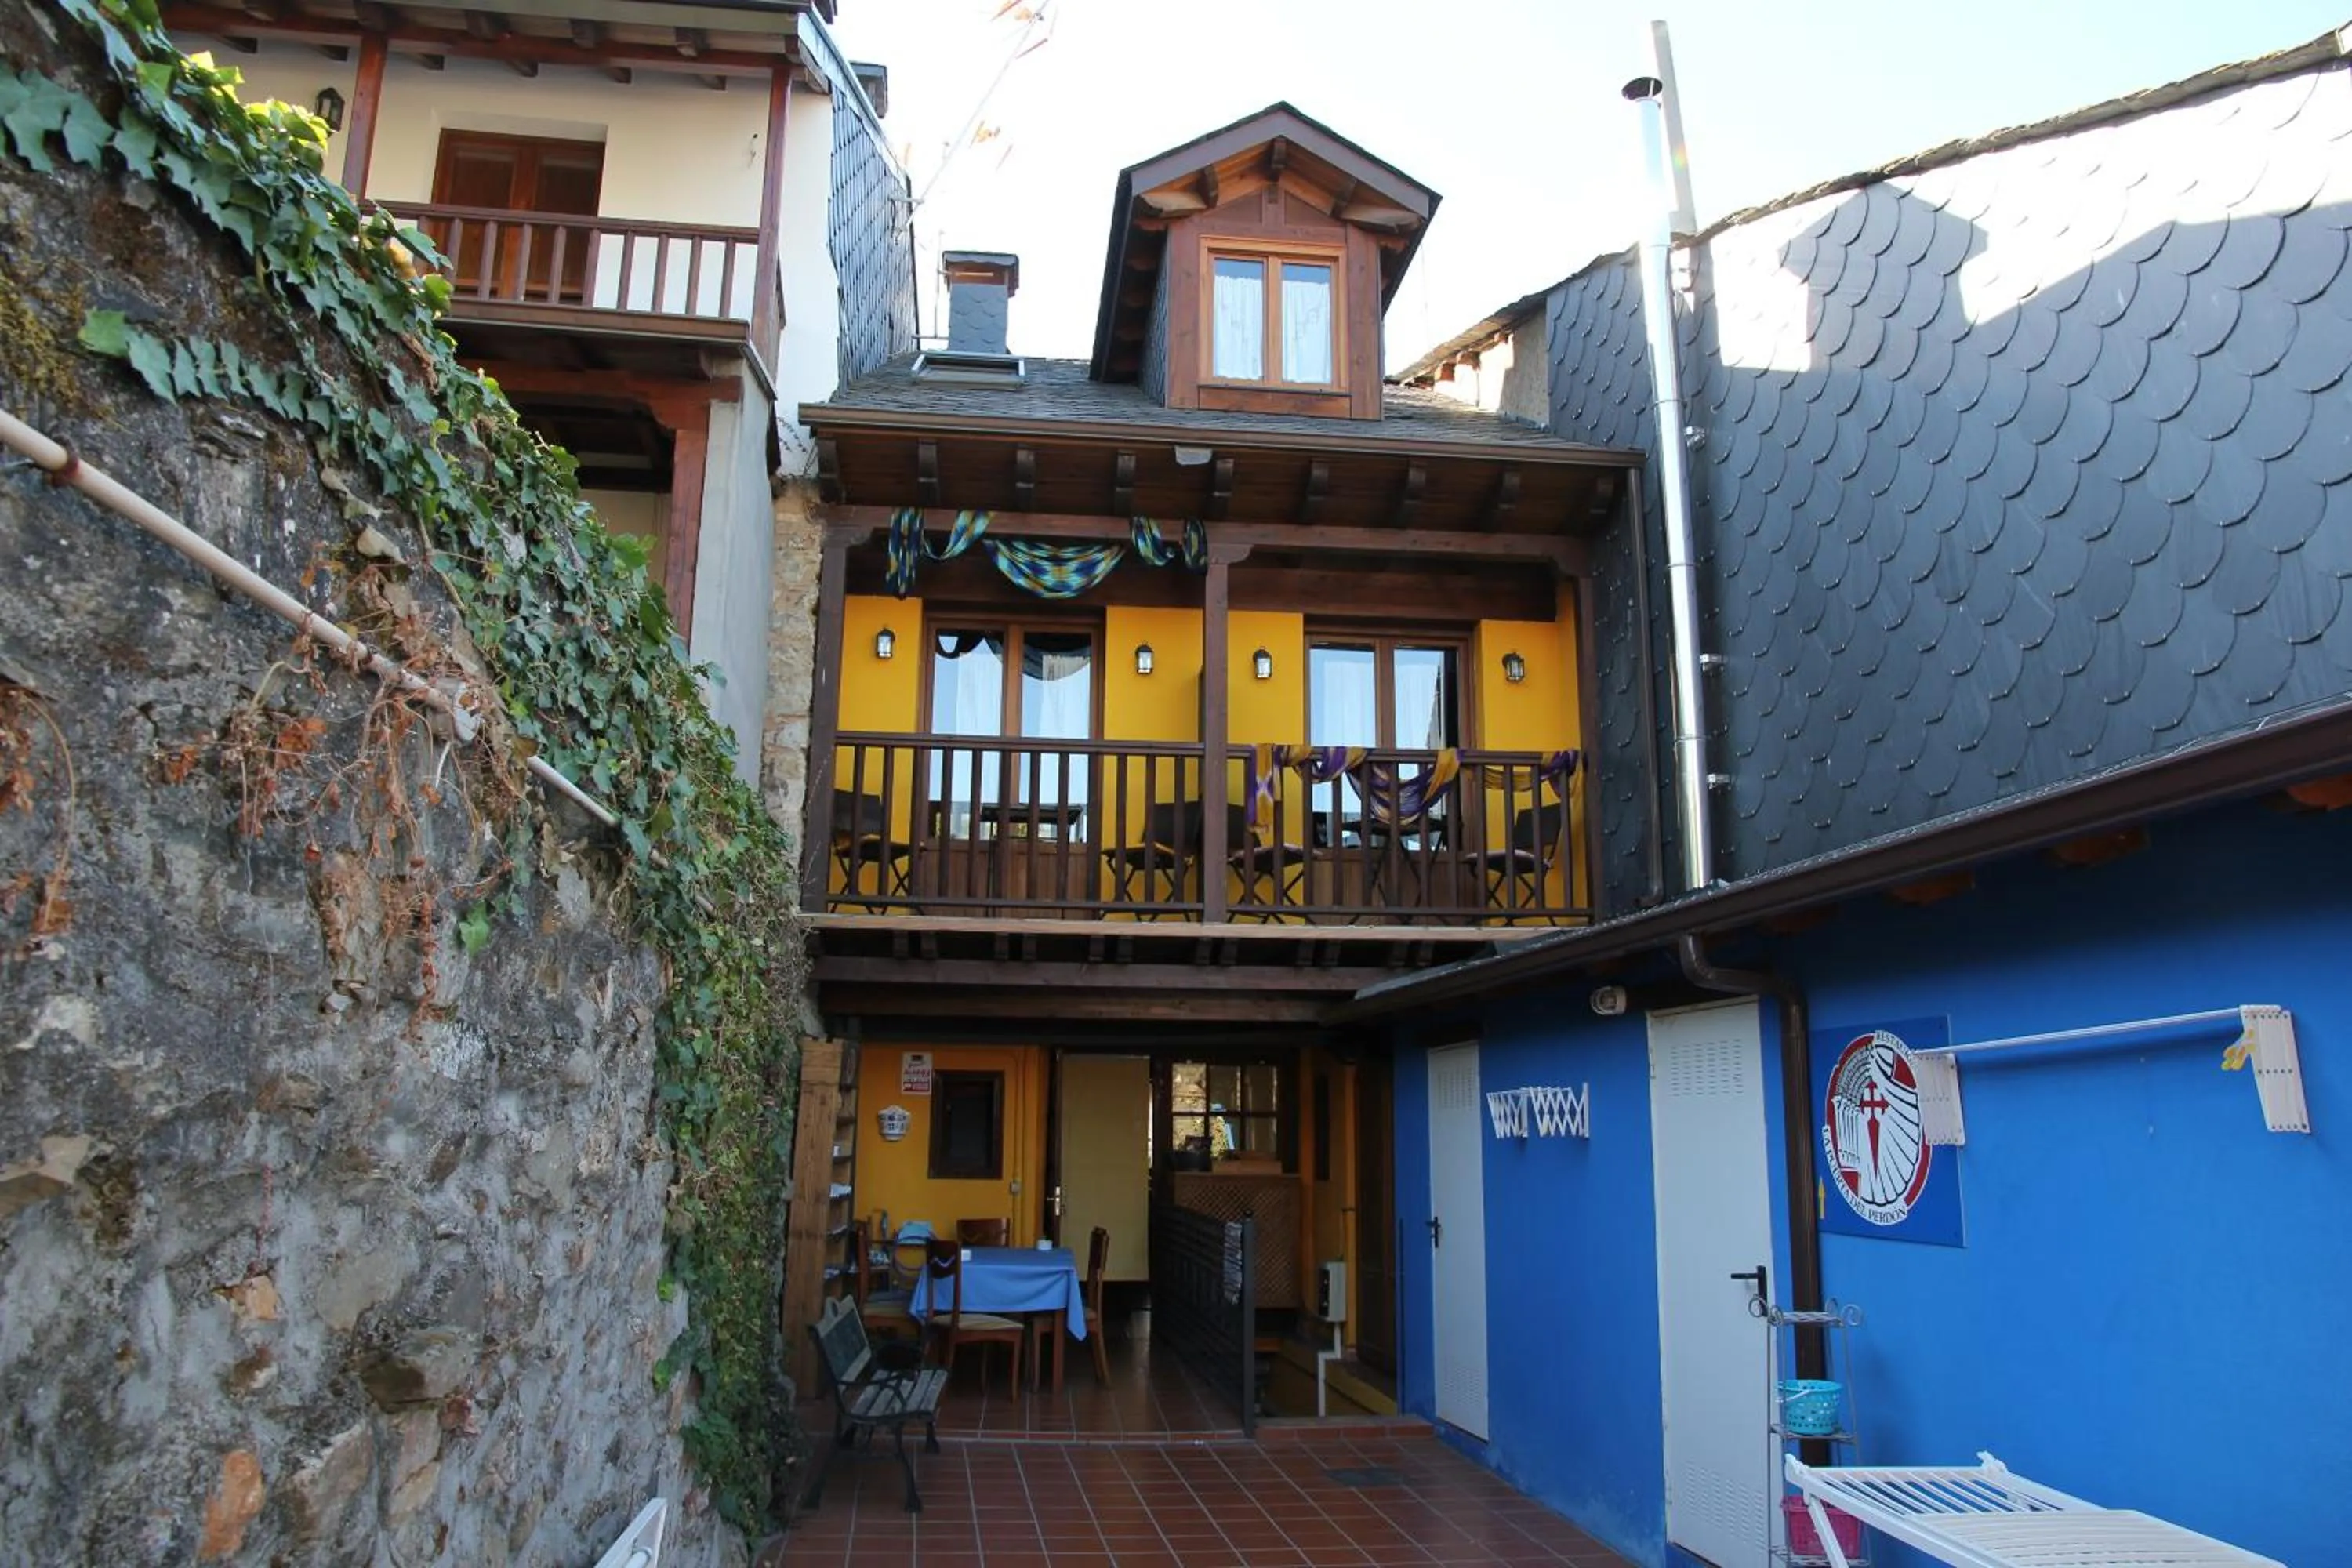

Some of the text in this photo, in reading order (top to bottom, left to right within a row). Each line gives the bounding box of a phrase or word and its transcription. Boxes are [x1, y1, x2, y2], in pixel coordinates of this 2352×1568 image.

[1823, 1128, 1831, 1145] LA
[1827, 1149, 1850, 1198] PUERTA
[1849, 1195, 1864, 1214] DEL
